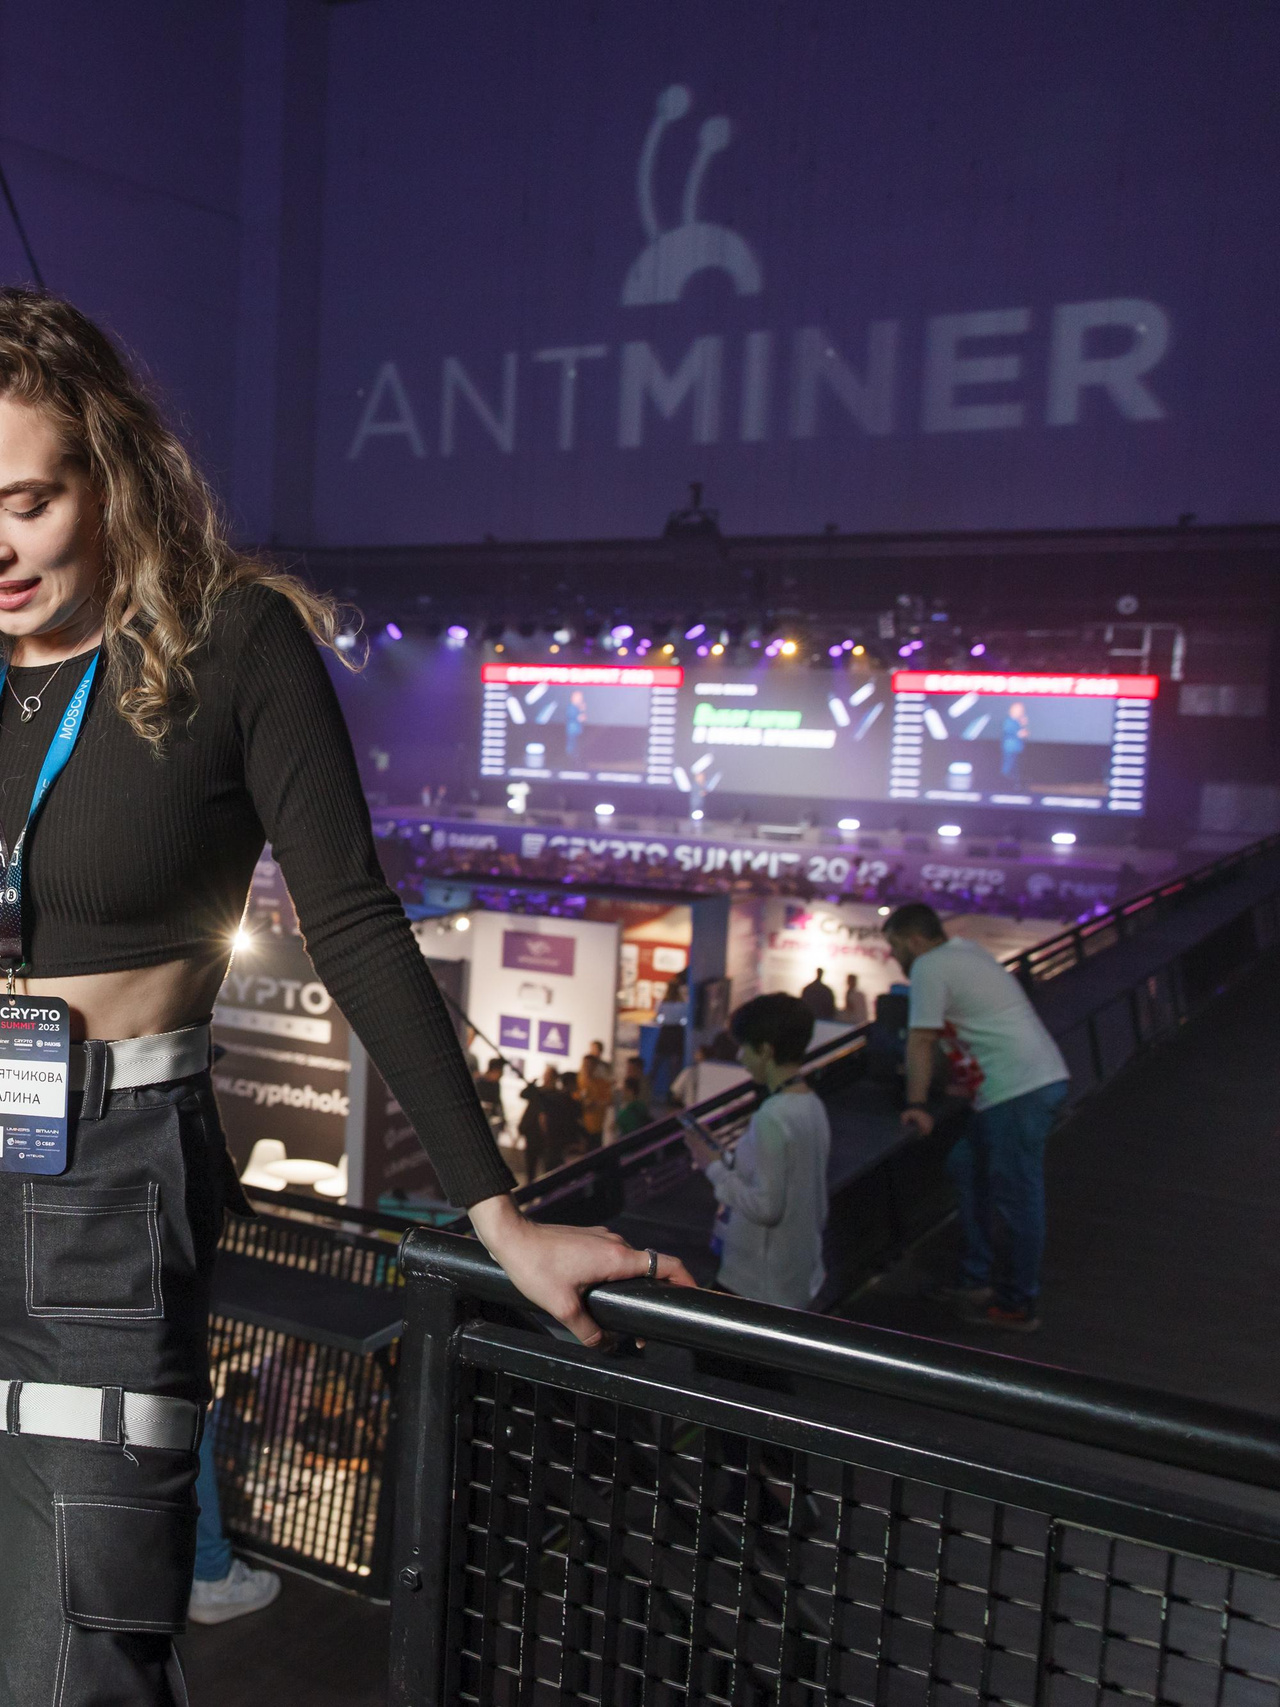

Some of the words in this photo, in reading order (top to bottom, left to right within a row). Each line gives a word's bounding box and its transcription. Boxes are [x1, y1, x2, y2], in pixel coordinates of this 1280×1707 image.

[347, 297, 1170, 459] ANTMINER
[59, 679, 90, 740] MOSCOW
[0, 1007, 60, 1022] CRYPTO
[0, 1021, 36, 1030] SUMMIT
[38, 1023, 60, 1032] 2023
